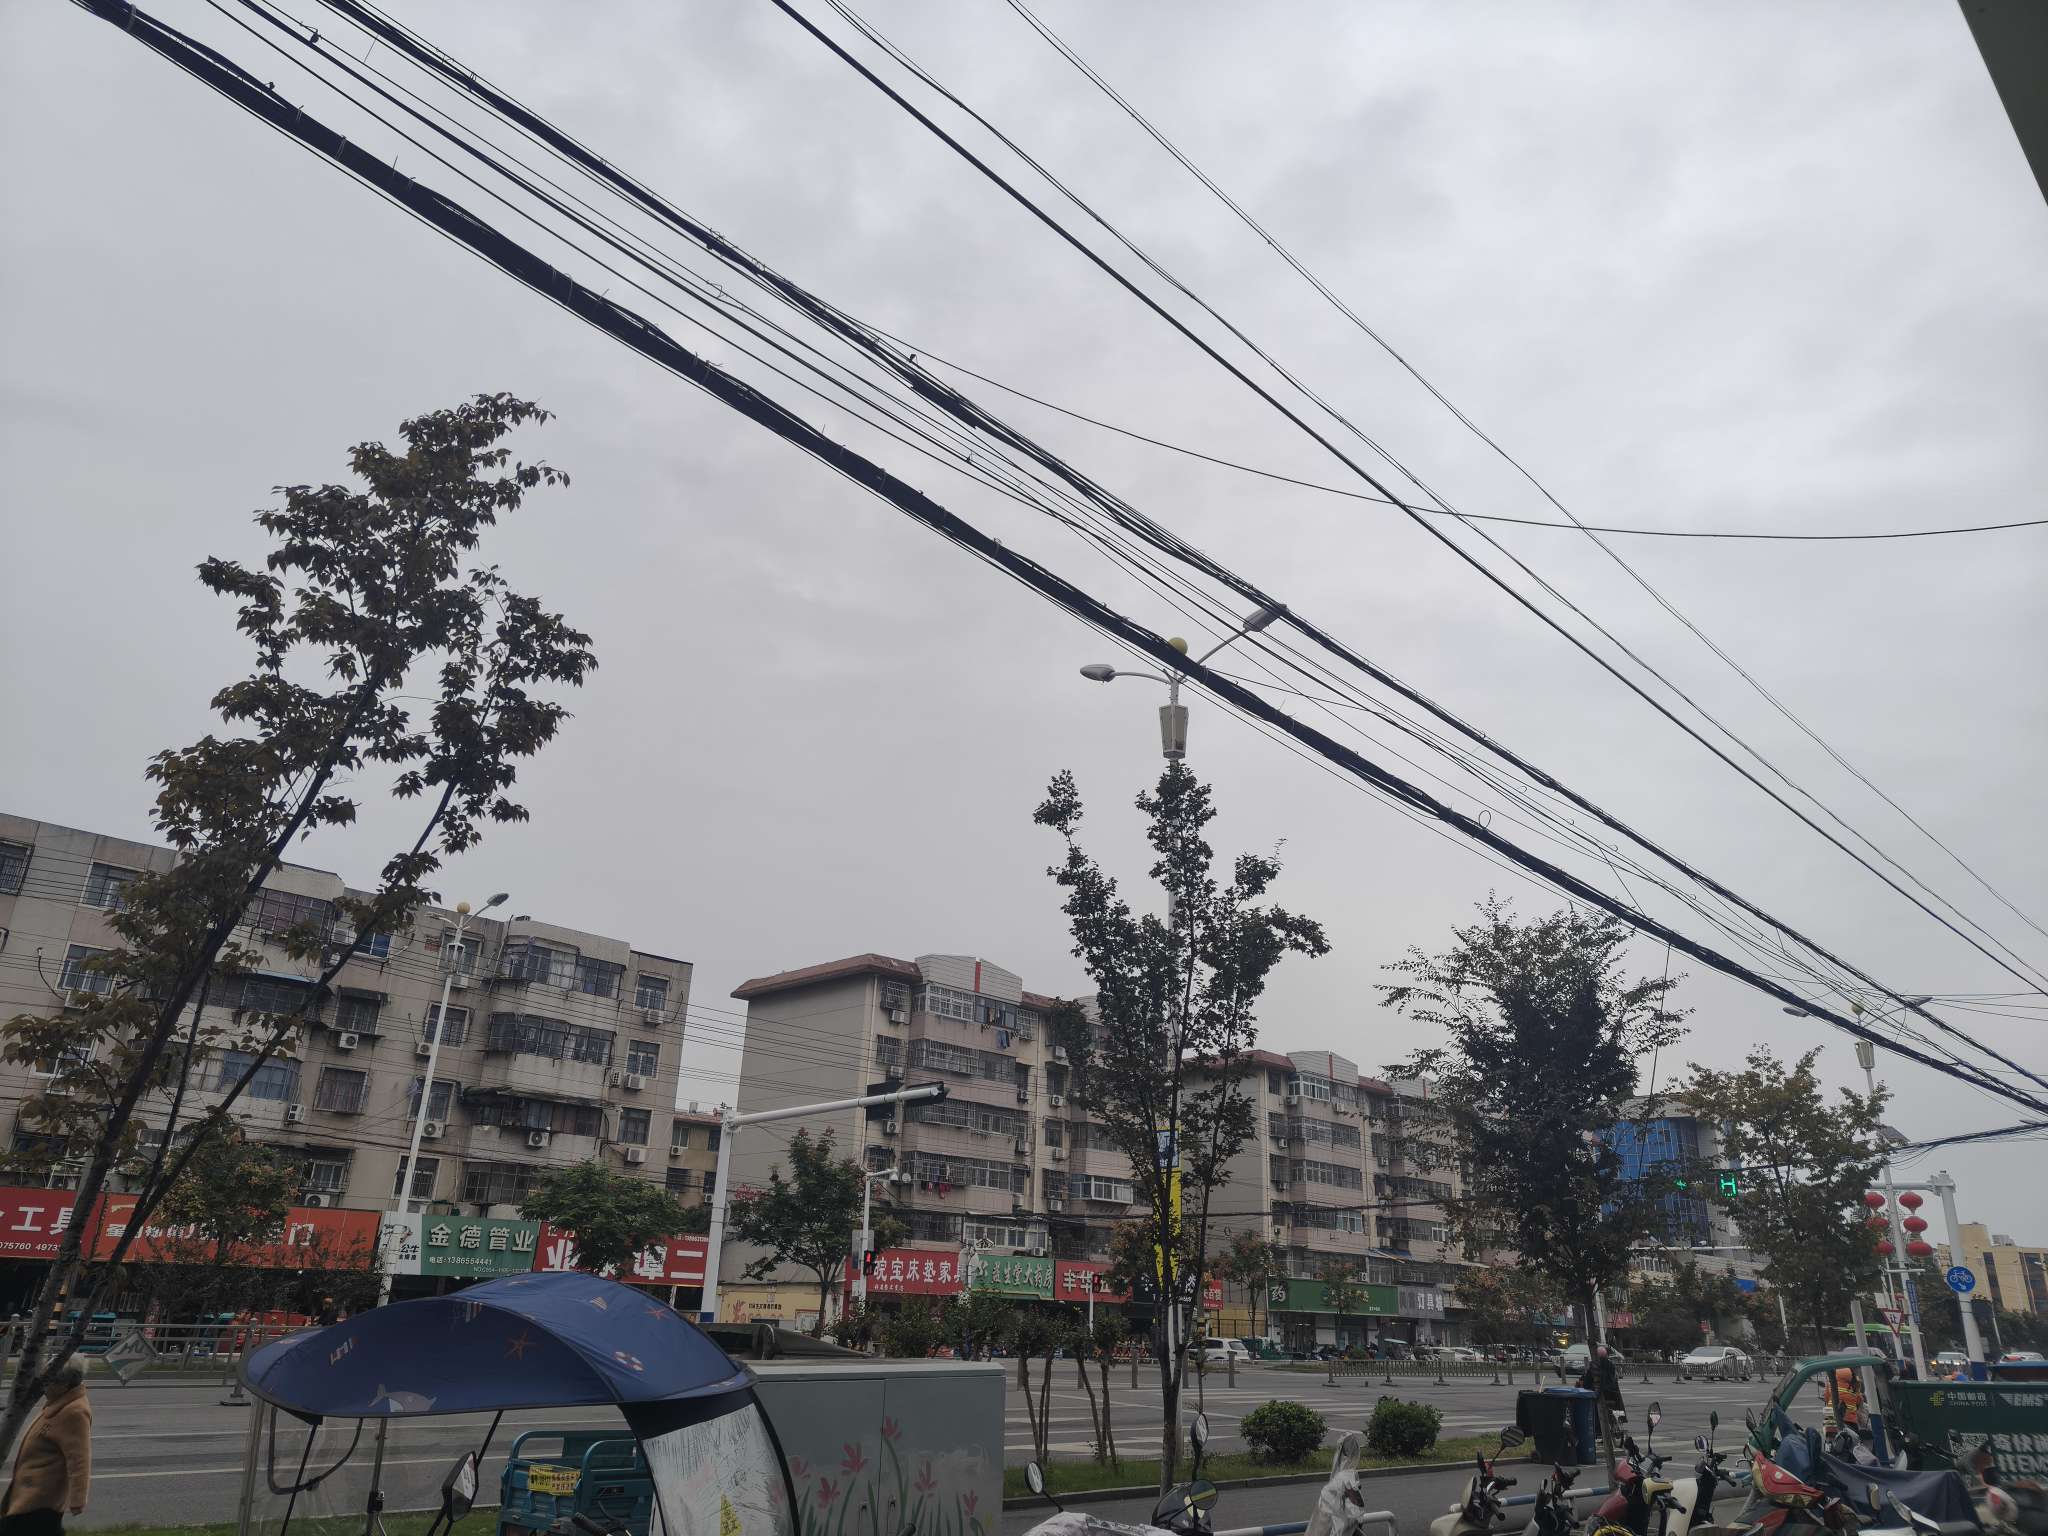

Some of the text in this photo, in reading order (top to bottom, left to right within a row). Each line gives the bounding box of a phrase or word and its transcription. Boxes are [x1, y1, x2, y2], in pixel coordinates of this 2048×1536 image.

[0, 1206, 73, 1235] 工具
[35, 1242, 59, 1252] 4973
[428, 1223, 534, 1252] 金德管业
[1063, 1269, 1129, 1294] 丰华五
[1947, 1392, 1986, 1401] 中国邮政
[2014, 1393, 2044, 1407] EMS
